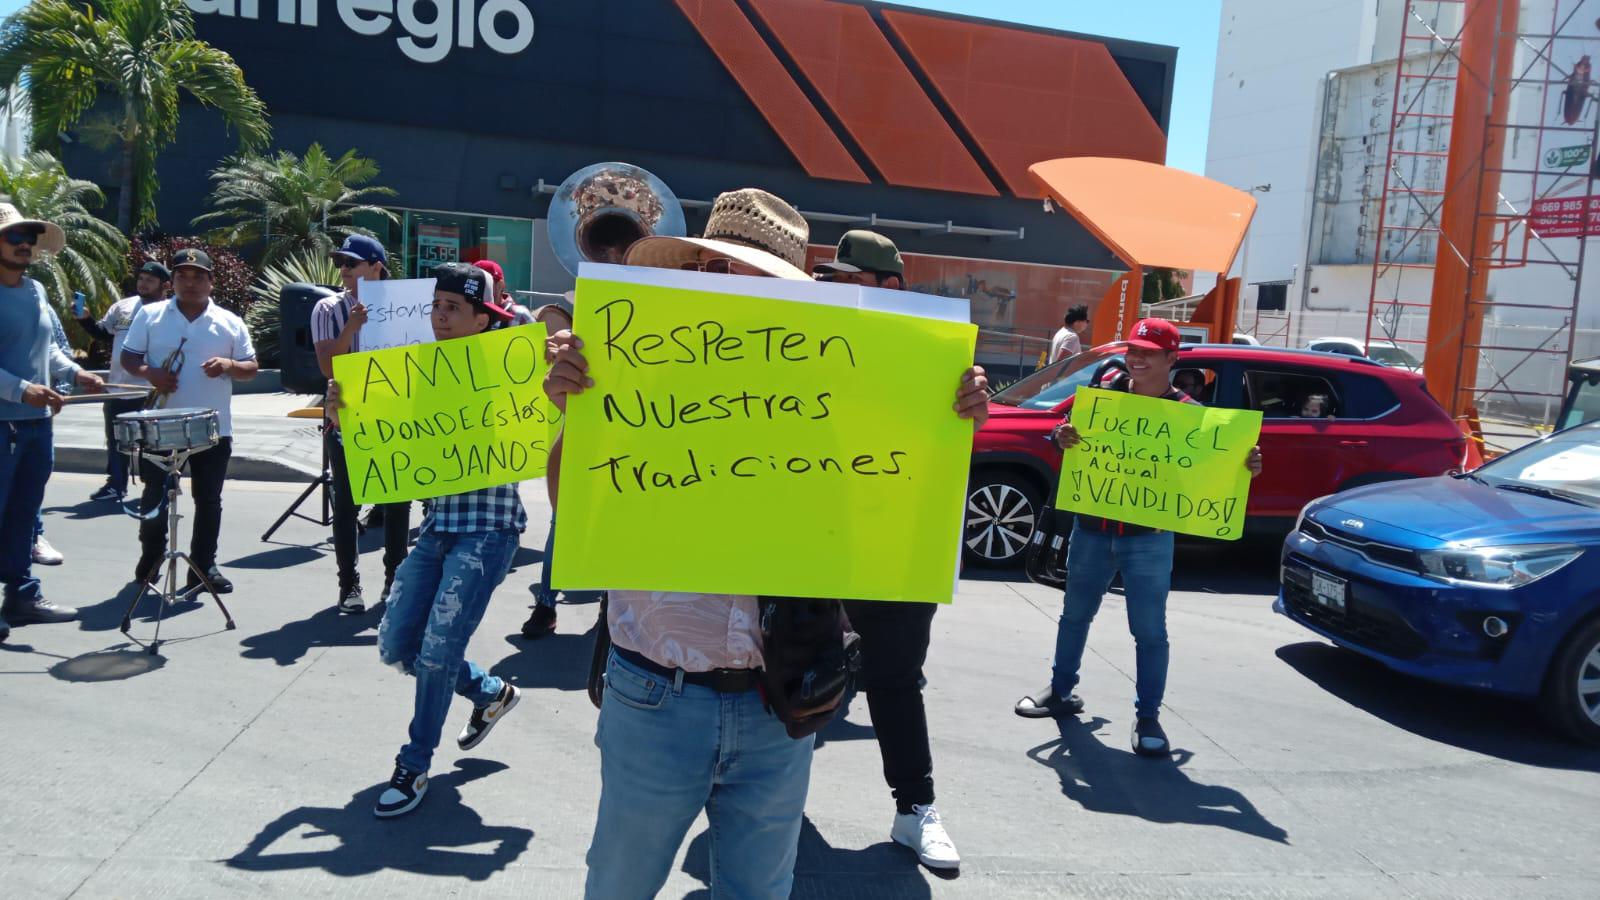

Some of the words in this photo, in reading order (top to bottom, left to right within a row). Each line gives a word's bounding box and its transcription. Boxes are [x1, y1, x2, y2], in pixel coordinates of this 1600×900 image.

[362, 335, 536, 403] AMLO
[1088, 396, 1171, 439] FUERA
[1185, 425, 1229, 451] EL
[1080, 436, 1192, 468] Sindicato
